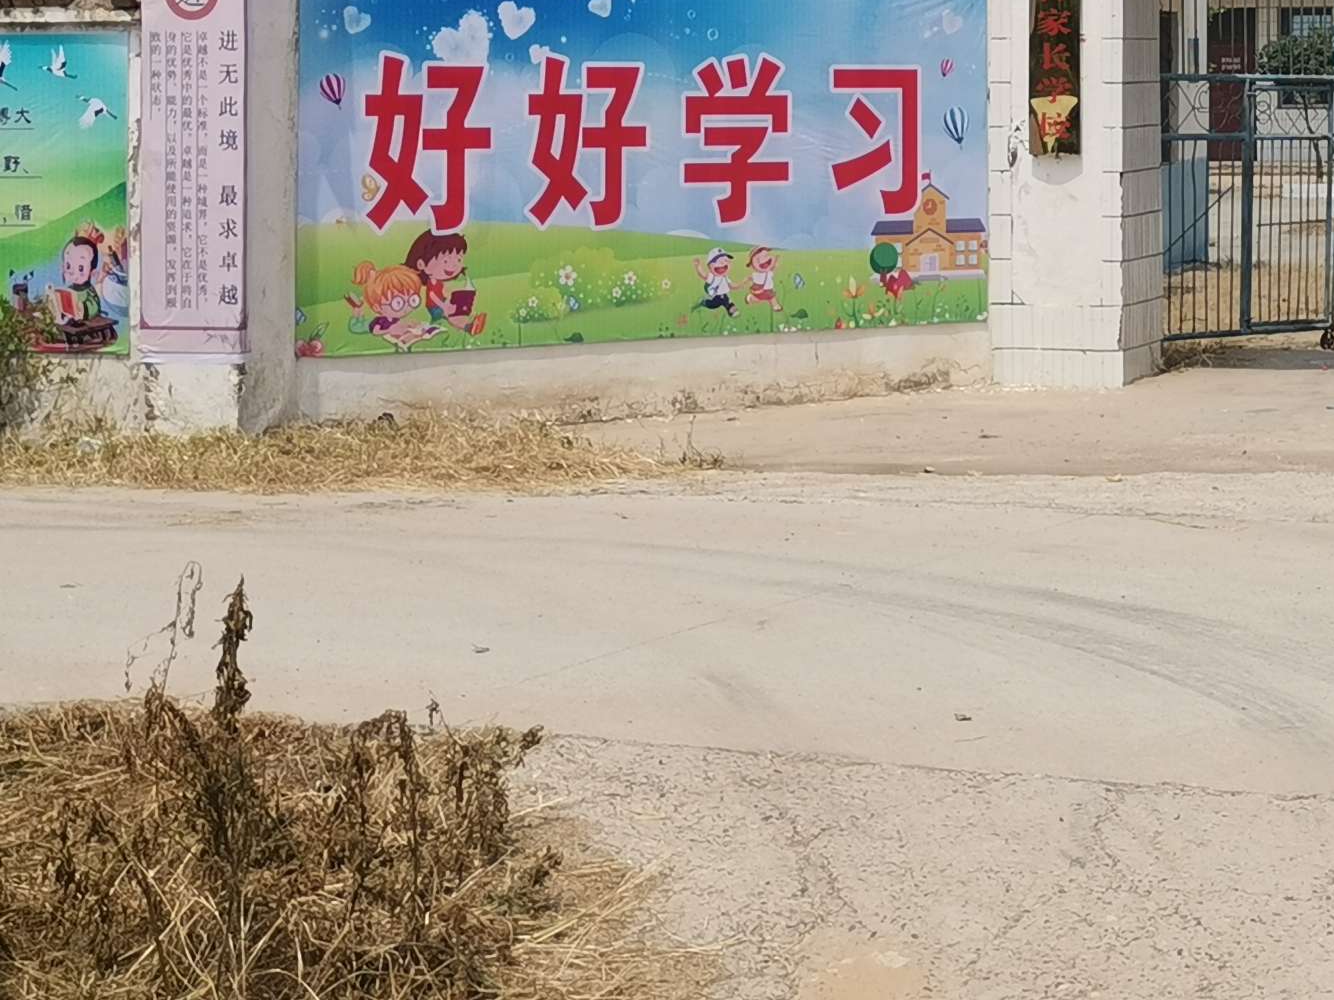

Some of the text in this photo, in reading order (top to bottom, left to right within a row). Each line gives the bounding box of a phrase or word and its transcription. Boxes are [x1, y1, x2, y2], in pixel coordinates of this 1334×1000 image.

[218, 29, 239, 306] 进无此境 最求卓越
[363, 52, 922, 232] 好好学习
